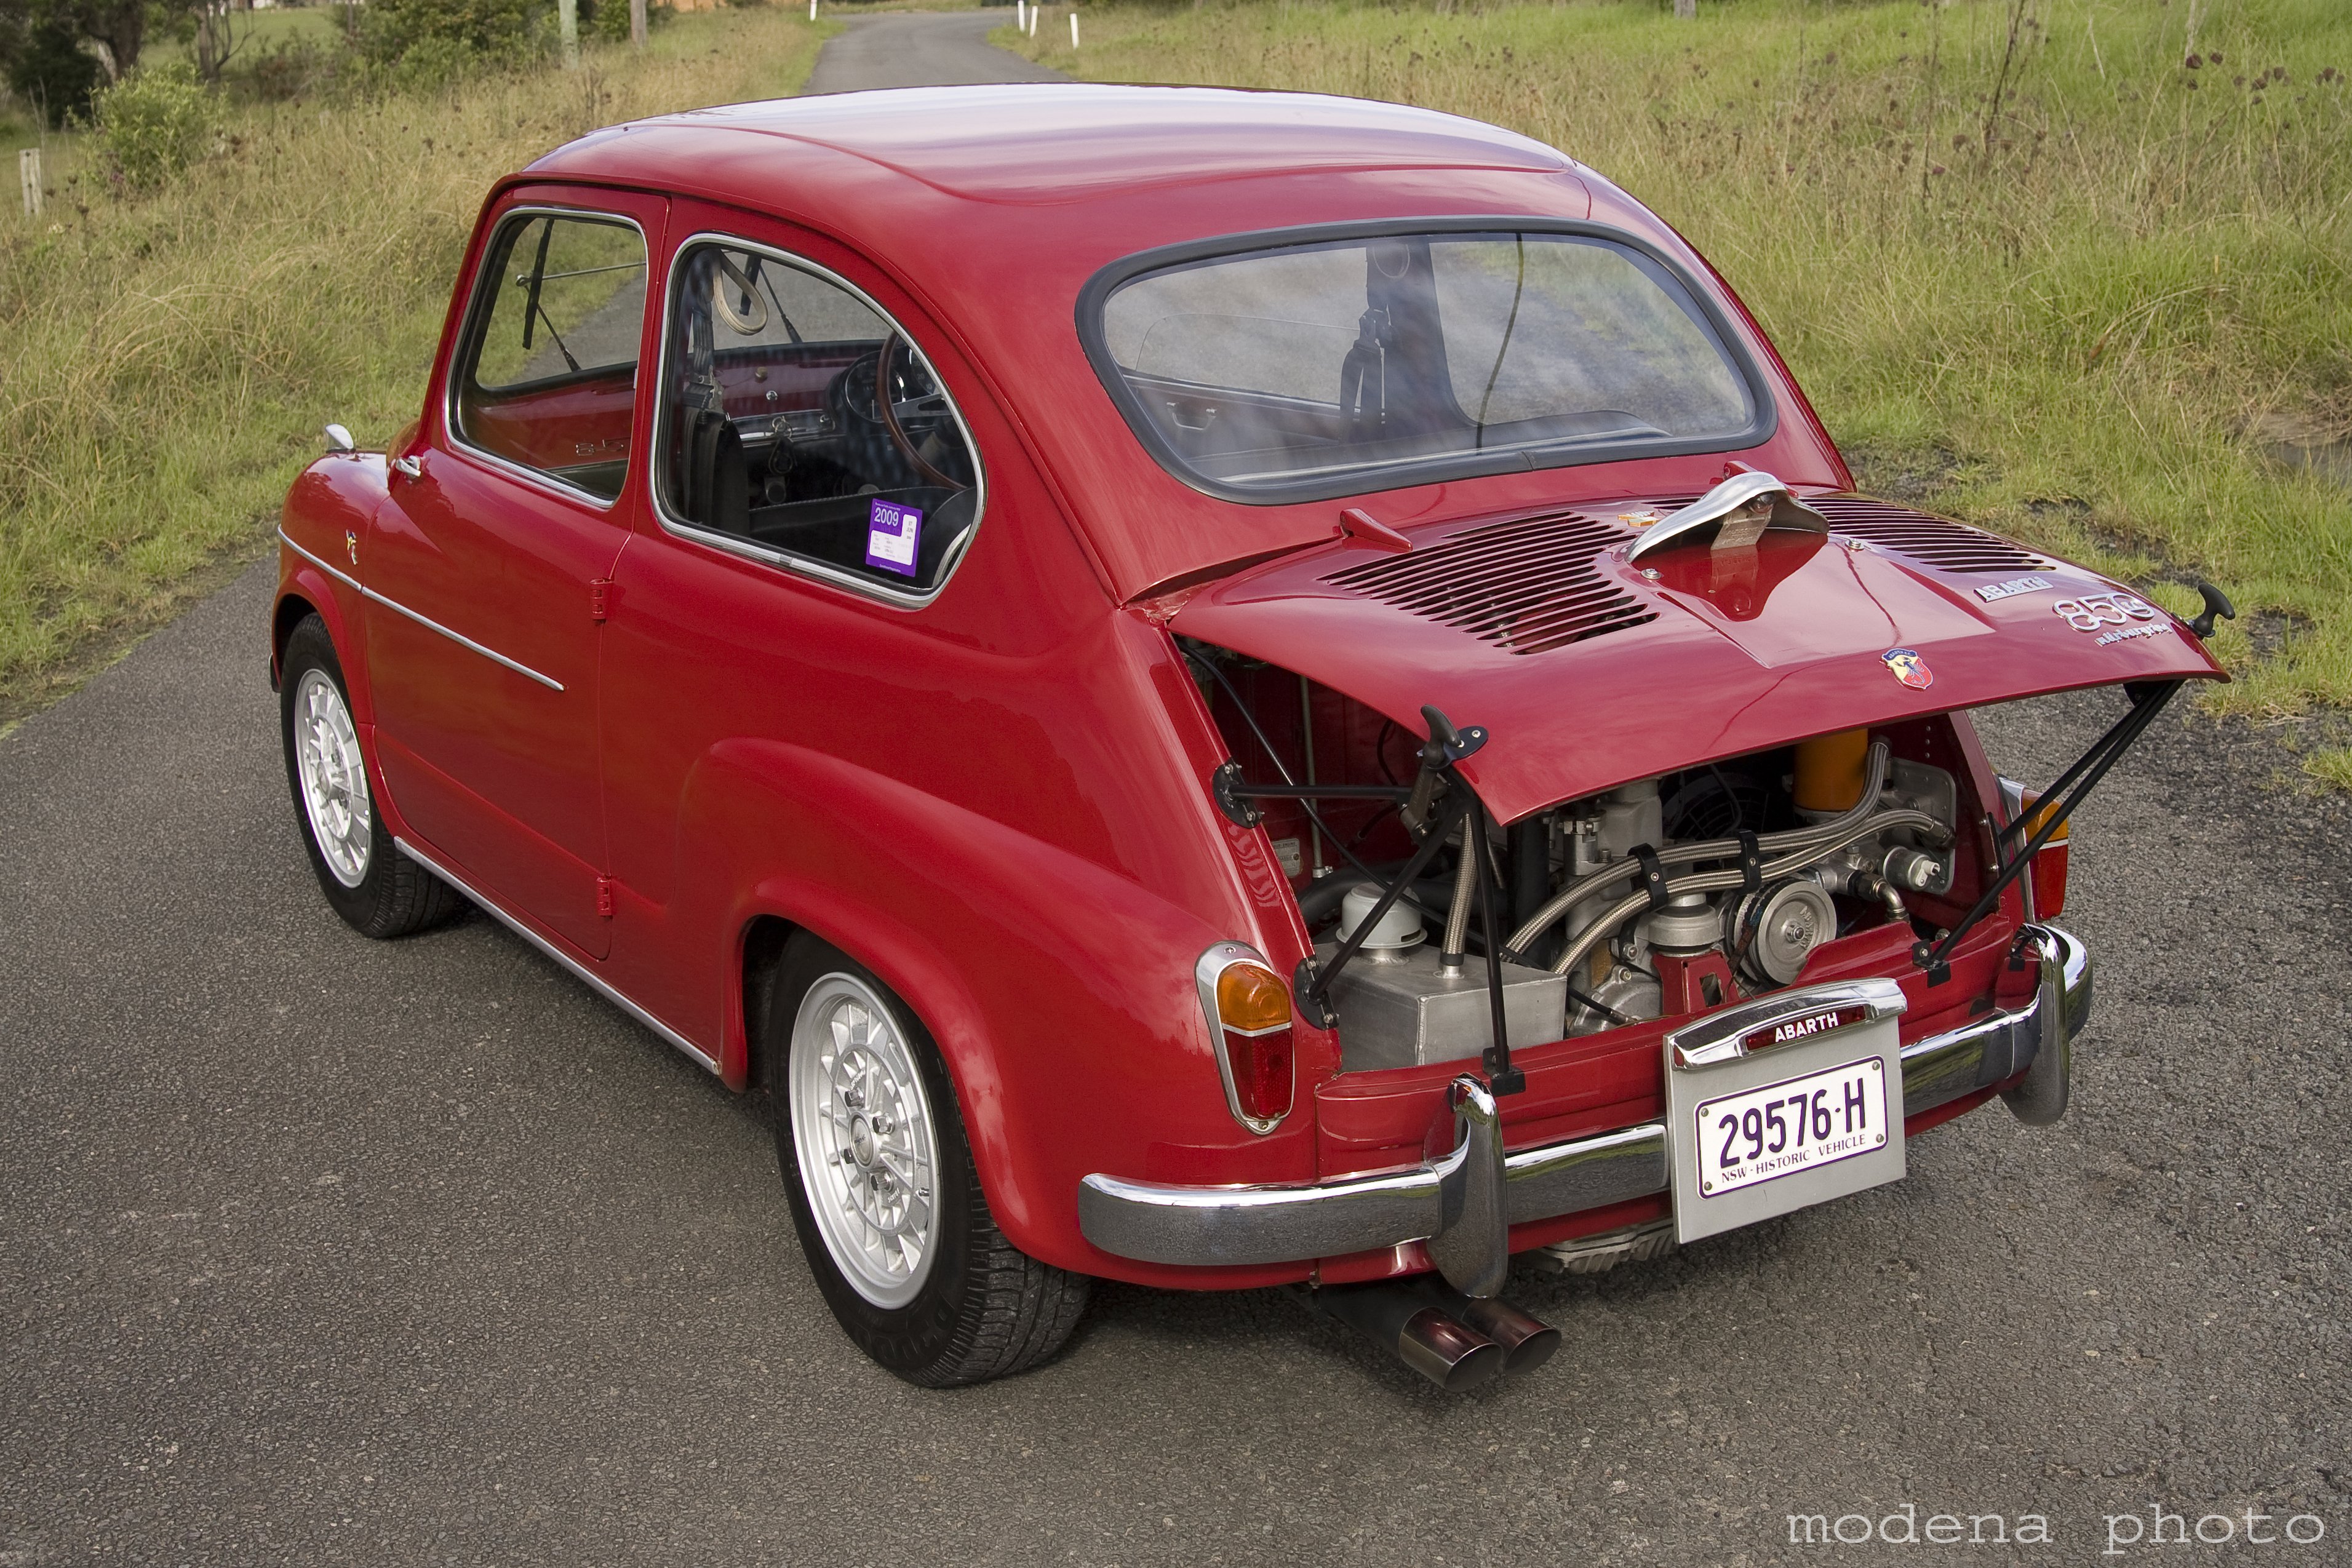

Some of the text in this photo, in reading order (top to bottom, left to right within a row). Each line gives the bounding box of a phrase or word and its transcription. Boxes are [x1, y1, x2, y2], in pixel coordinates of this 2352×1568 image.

[874, 507, 899, 527] 2009
[1974, 576, 2054, 603] ABARTH
[2052, 592, 2155, 633] 850
[1775, 1012, 1838, 1043] ABARTH
[1721, 1166, 1747, 1183] NSW
[1756, 1150, 1811, 1174] HISTORIC
[1818, 1134, 1866, 1156] VEHICLE
